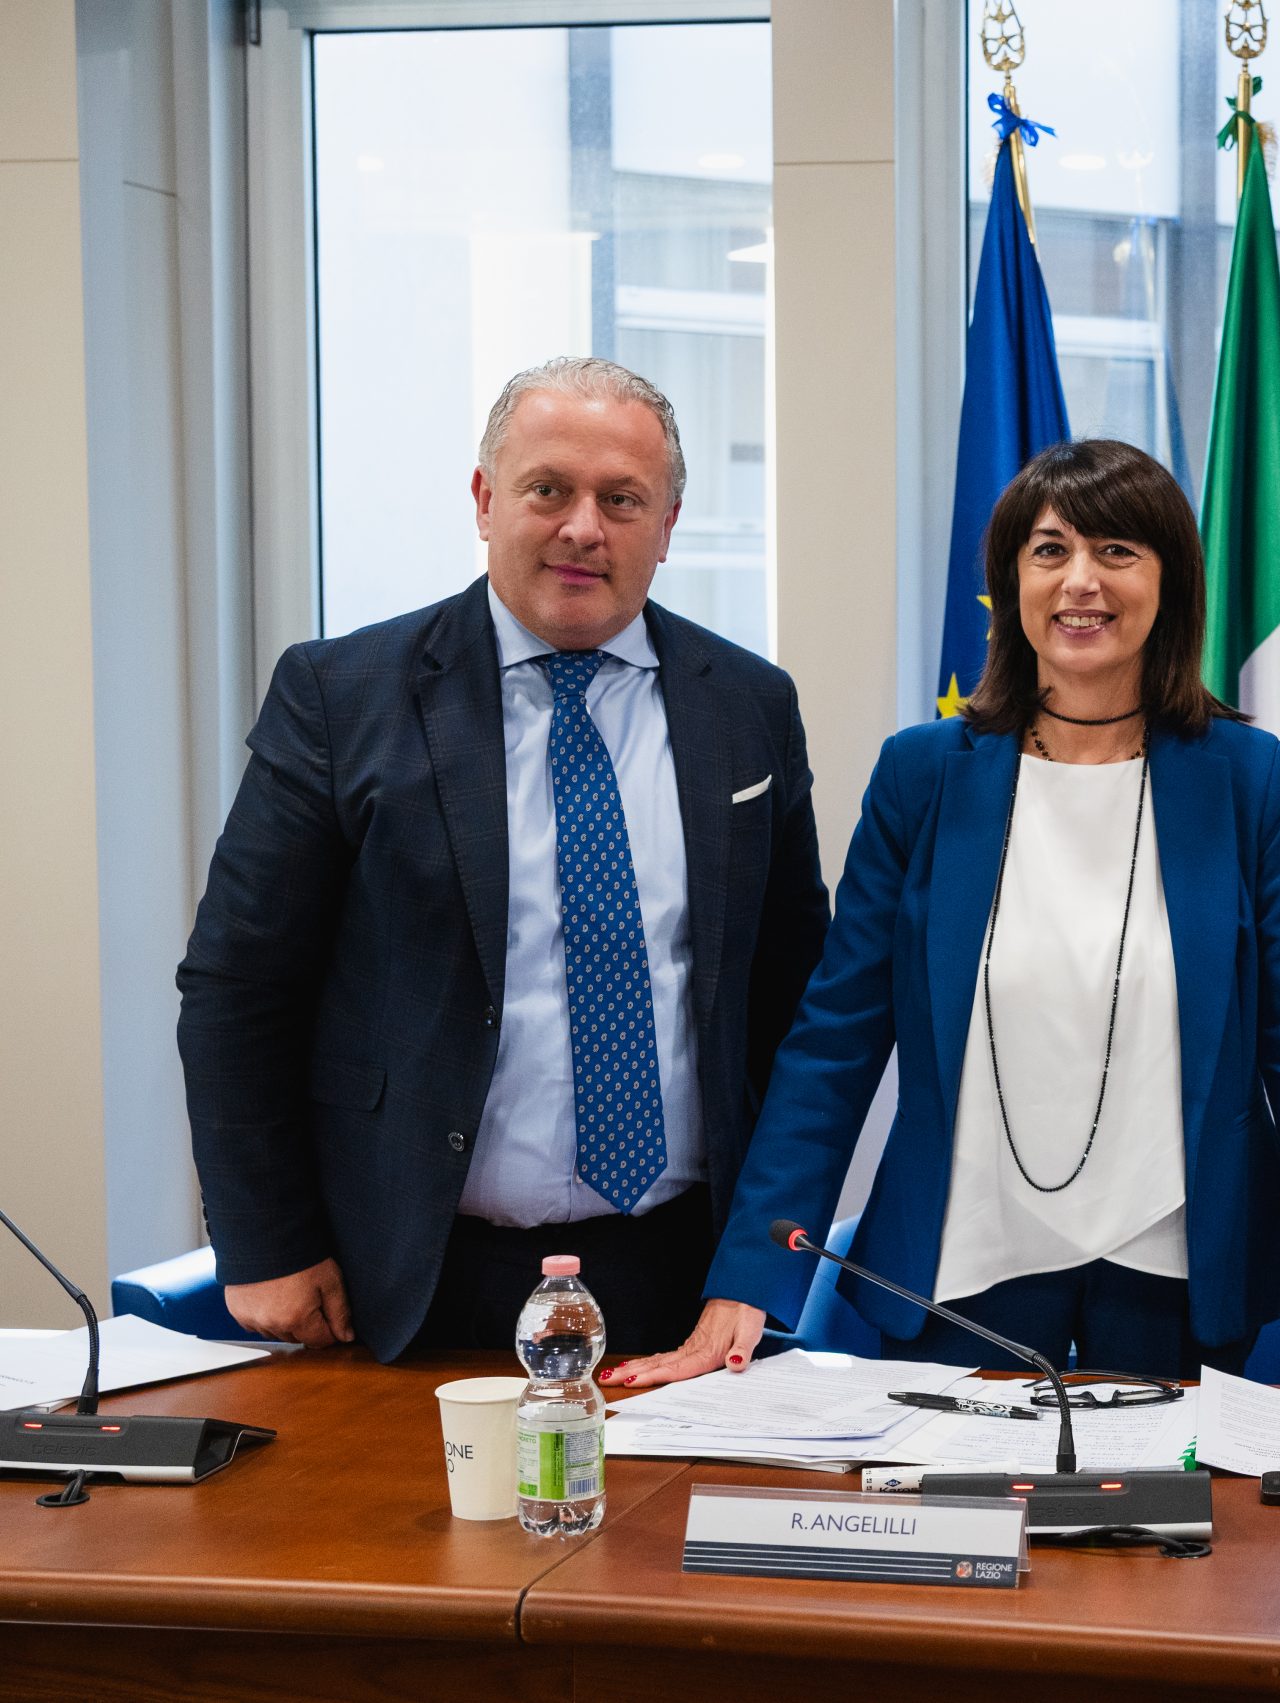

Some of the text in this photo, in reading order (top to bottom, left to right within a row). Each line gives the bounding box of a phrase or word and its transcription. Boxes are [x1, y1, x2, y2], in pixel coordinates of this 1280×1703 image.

[445, 1441, 474, 1460] ONE
[447, 1458, 455, 1473] O
[810, 1513, 917, 1536] ANGELILLI
[975, 1562, 1013, 1572] REGIONE
[975, 1571, 1001, 1580] LAZIO
